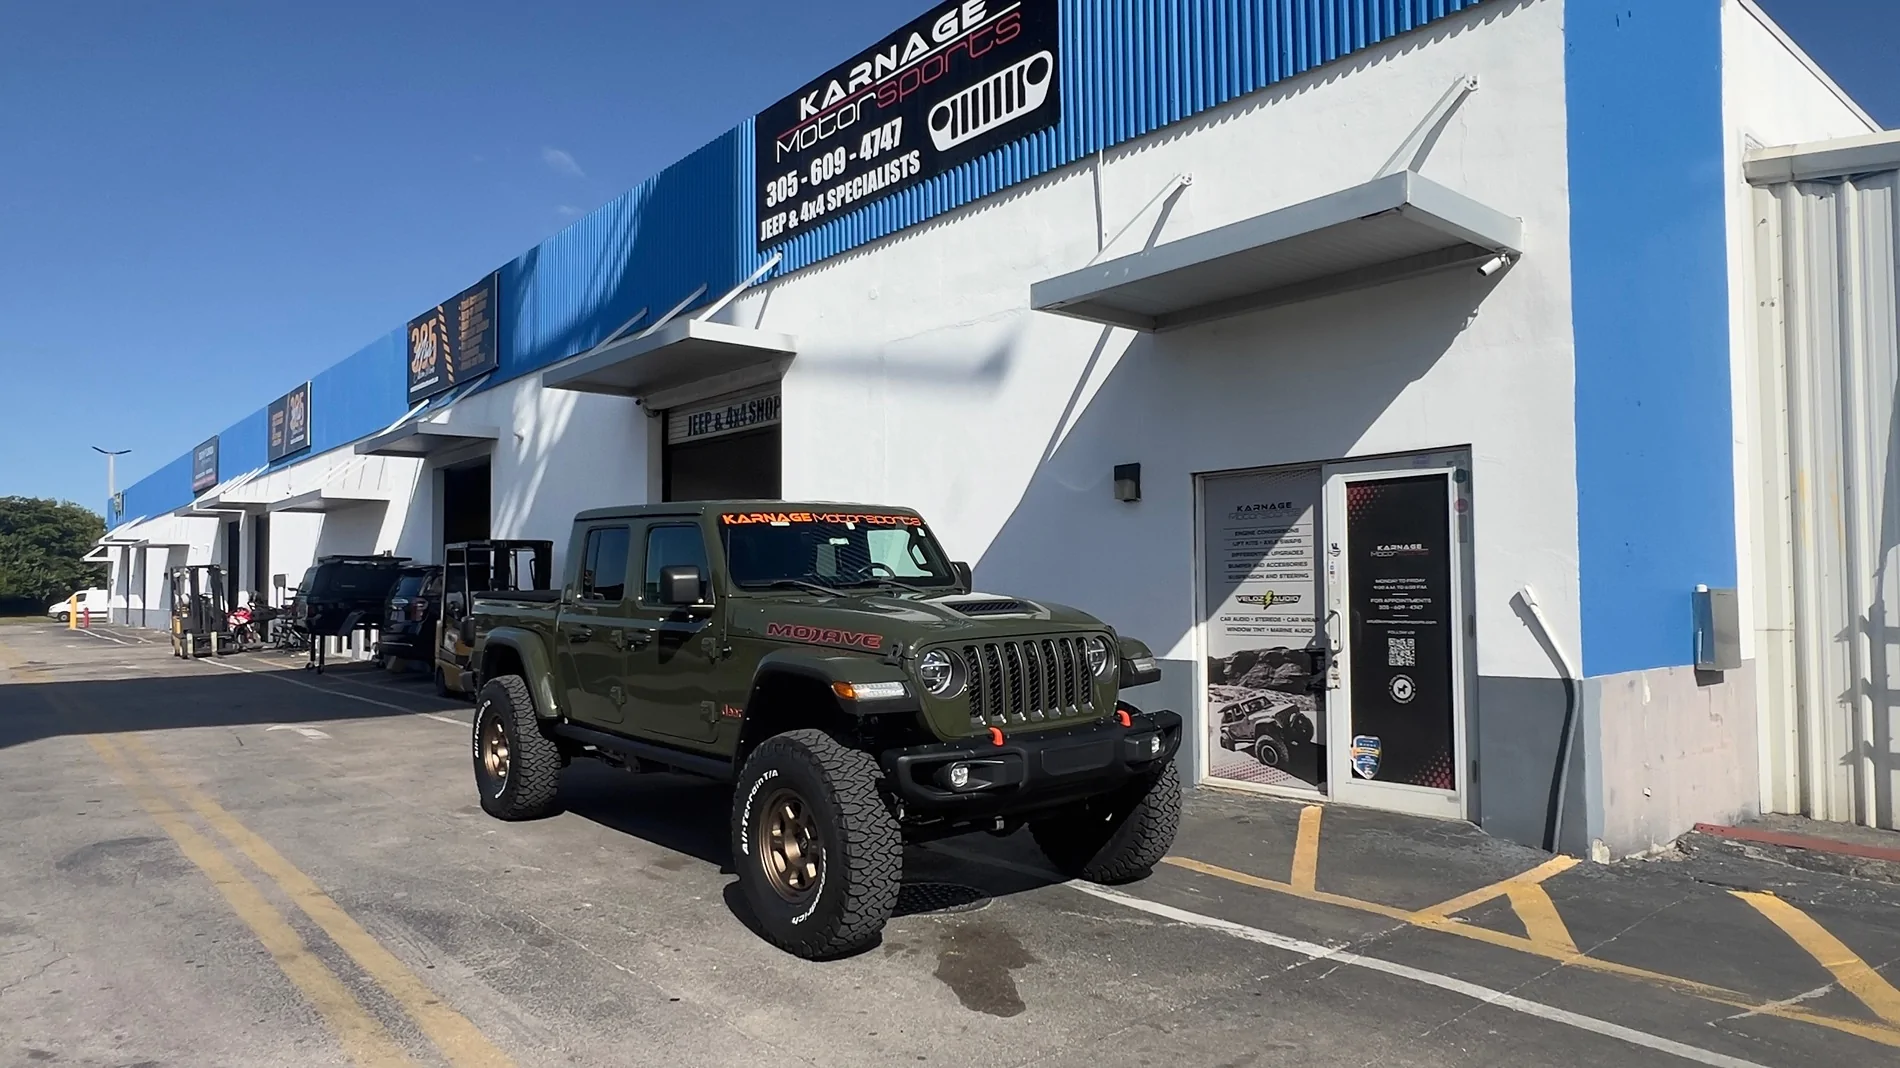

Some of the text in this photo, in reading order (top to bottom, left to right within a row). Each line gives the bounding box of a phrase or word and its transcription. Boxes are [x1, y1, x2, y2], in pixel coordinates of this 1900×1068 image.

[776, 12, 1021, 163] Motorsports
[799, 0, 988, 122] KARNAGE
[766, 170, 799, 208] 305
[810, 146, 846, 186] 609
[859, 116, 902, 161] 4747
[760, 150, 920, 242] JEEP & 4x4 SPECIALISTS
[687, 395, 781, 436] JEEP & 4x4 SHOP
[722, 512, 812, 525] KARNAGE
[1236, 502, 1292, 512] KARNAGE
[1376, 543, 1422, 551] KARNAGE
[766, 622, 884, 649] MOJAVE
[741, 768, 779, 856] All-Terrain T/A
